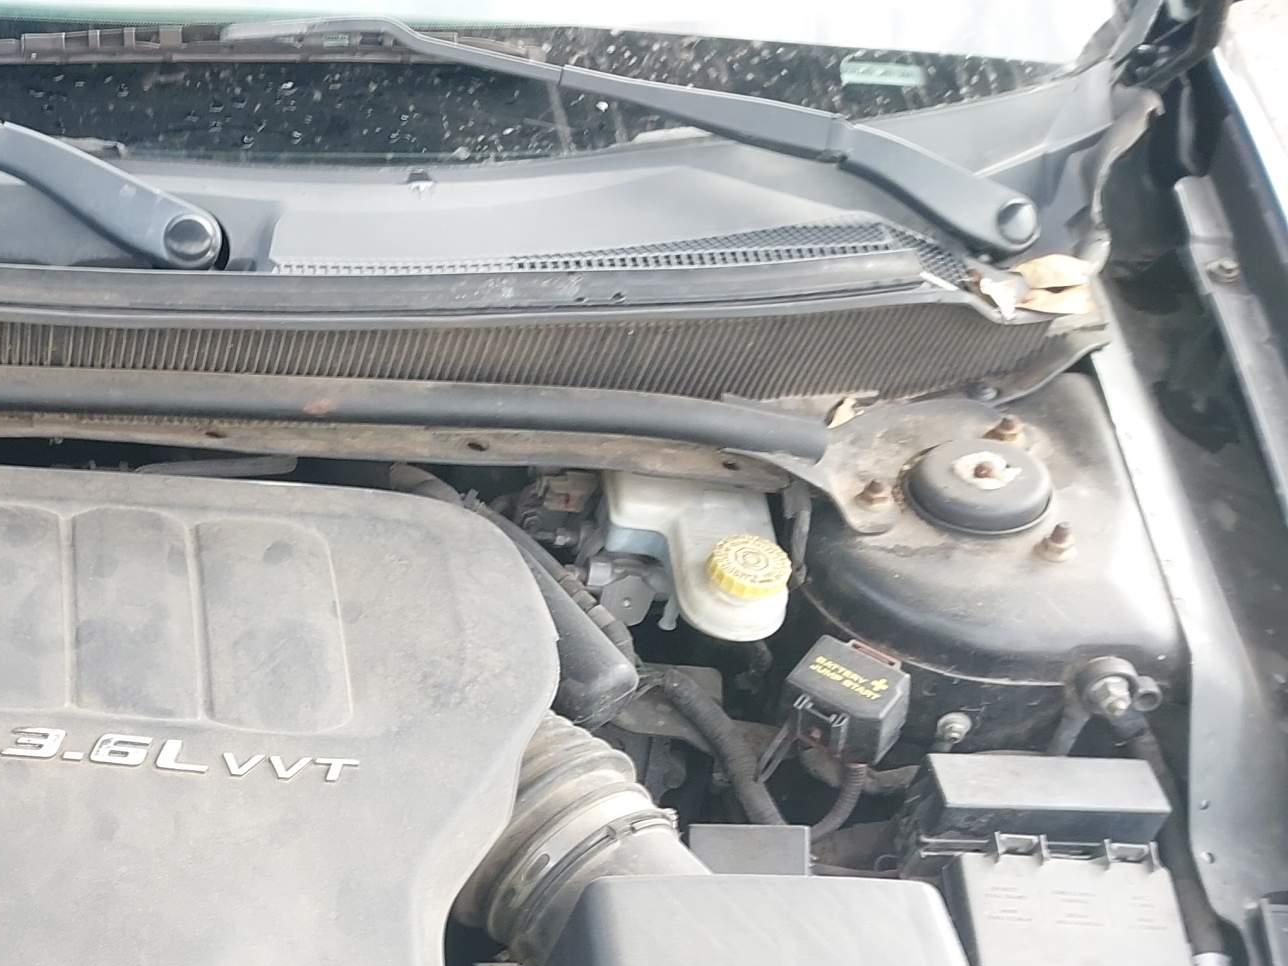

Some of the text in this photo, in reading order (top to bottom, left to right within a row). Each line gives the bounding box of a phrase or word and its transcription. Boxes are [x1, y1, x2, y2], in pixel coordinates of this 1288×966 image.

[809, 664, 881, 700] JUMP START
[815, 655, 869, 684] BATTERY
[0, 727, 360, 782] 3.6L VVT
